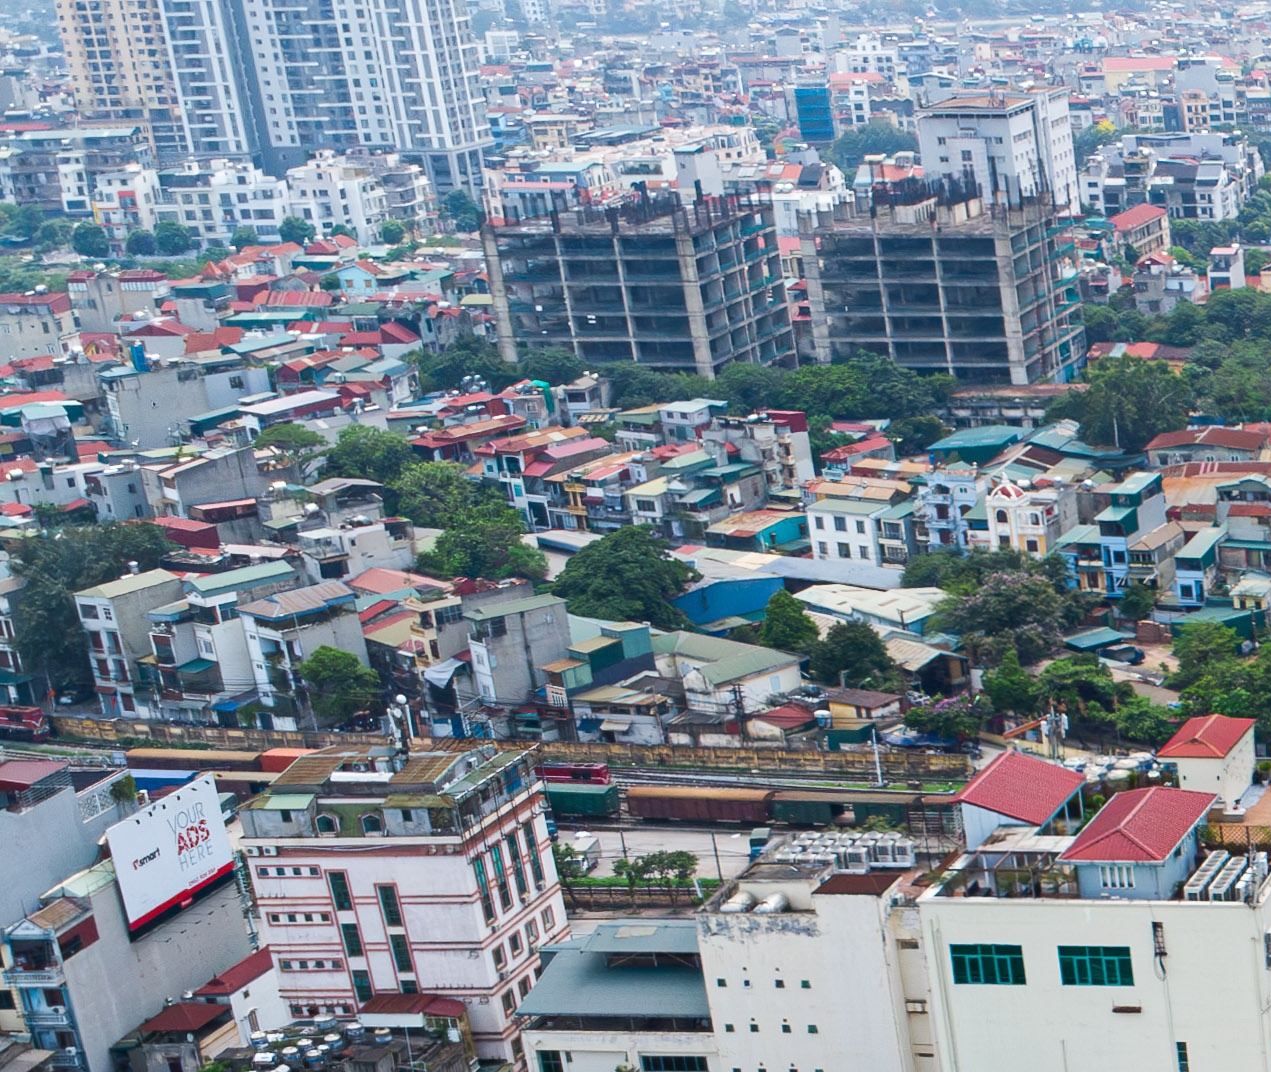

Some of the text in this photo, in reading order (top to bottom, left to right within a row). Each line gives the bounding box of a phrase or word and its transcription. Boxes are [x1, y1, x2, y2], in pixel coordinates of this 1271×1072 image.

[166, 802, 205, 846] YOUR
[177, 819, 211, 856] ADS
[178, 839, 214, 872] HERE
